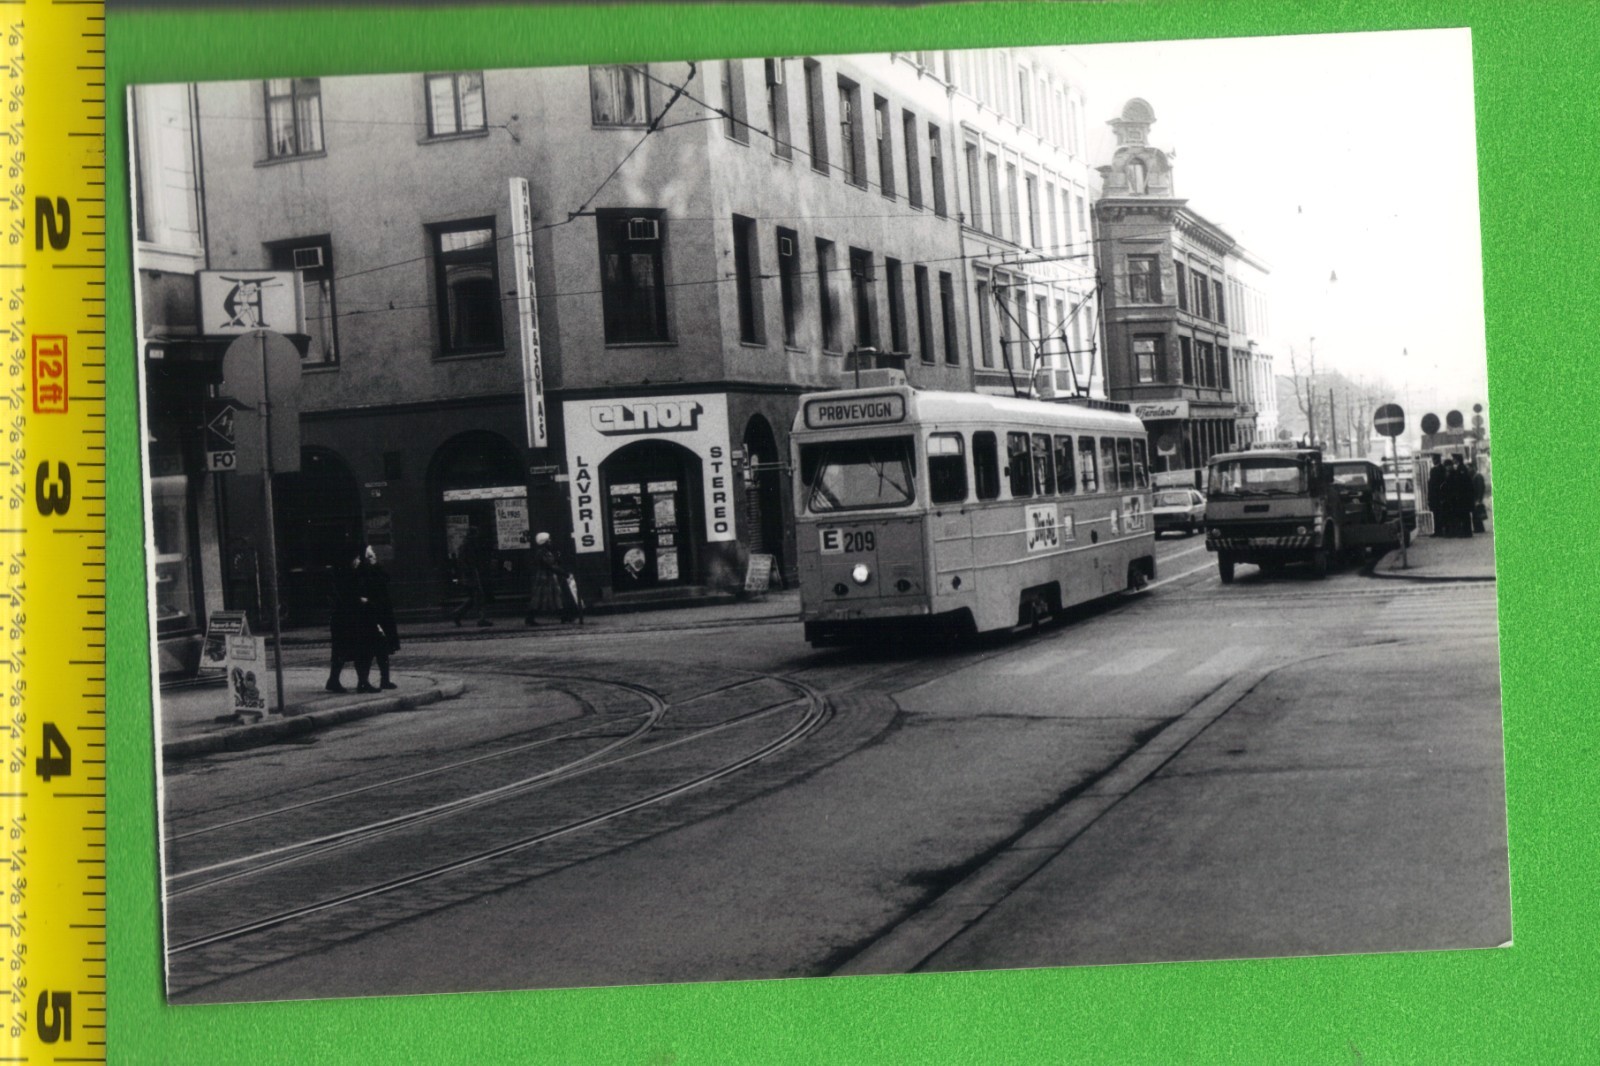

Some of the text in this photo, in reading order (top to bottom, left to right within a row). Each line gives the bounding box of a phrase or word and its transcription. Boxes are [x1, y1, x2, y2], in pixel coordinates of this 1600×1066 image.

[8, 19, 25, 246] 1/8 1/4 3/8 1/2 5/8 3/4 7/8
[35, 196, 71, 251] 2
[9, 285, 26, 510] 1/8 1/4 3/8 1/2 5/8 3/4 7/8
[818, 402, 892, 421] PRØVEVOGN
[36, 460, 71, 516] 3
[213, 452, 236, 468] FO
[576, 455, 596, 547] LAVPRIS
[710, 446, 728, 536] STEREO
[823, 530, 875, 553] E 209
[9, 549, 27, 774] 1/8 1/4 3/8 1/2 5/8 3/4 7/8
[36, 722, 72, 782] 4
[10, 813, 27, 1038] 1/8 1/4 3/8 1/2 5/8 3/4 7/8
[37, 989, 72, 1043] 5
